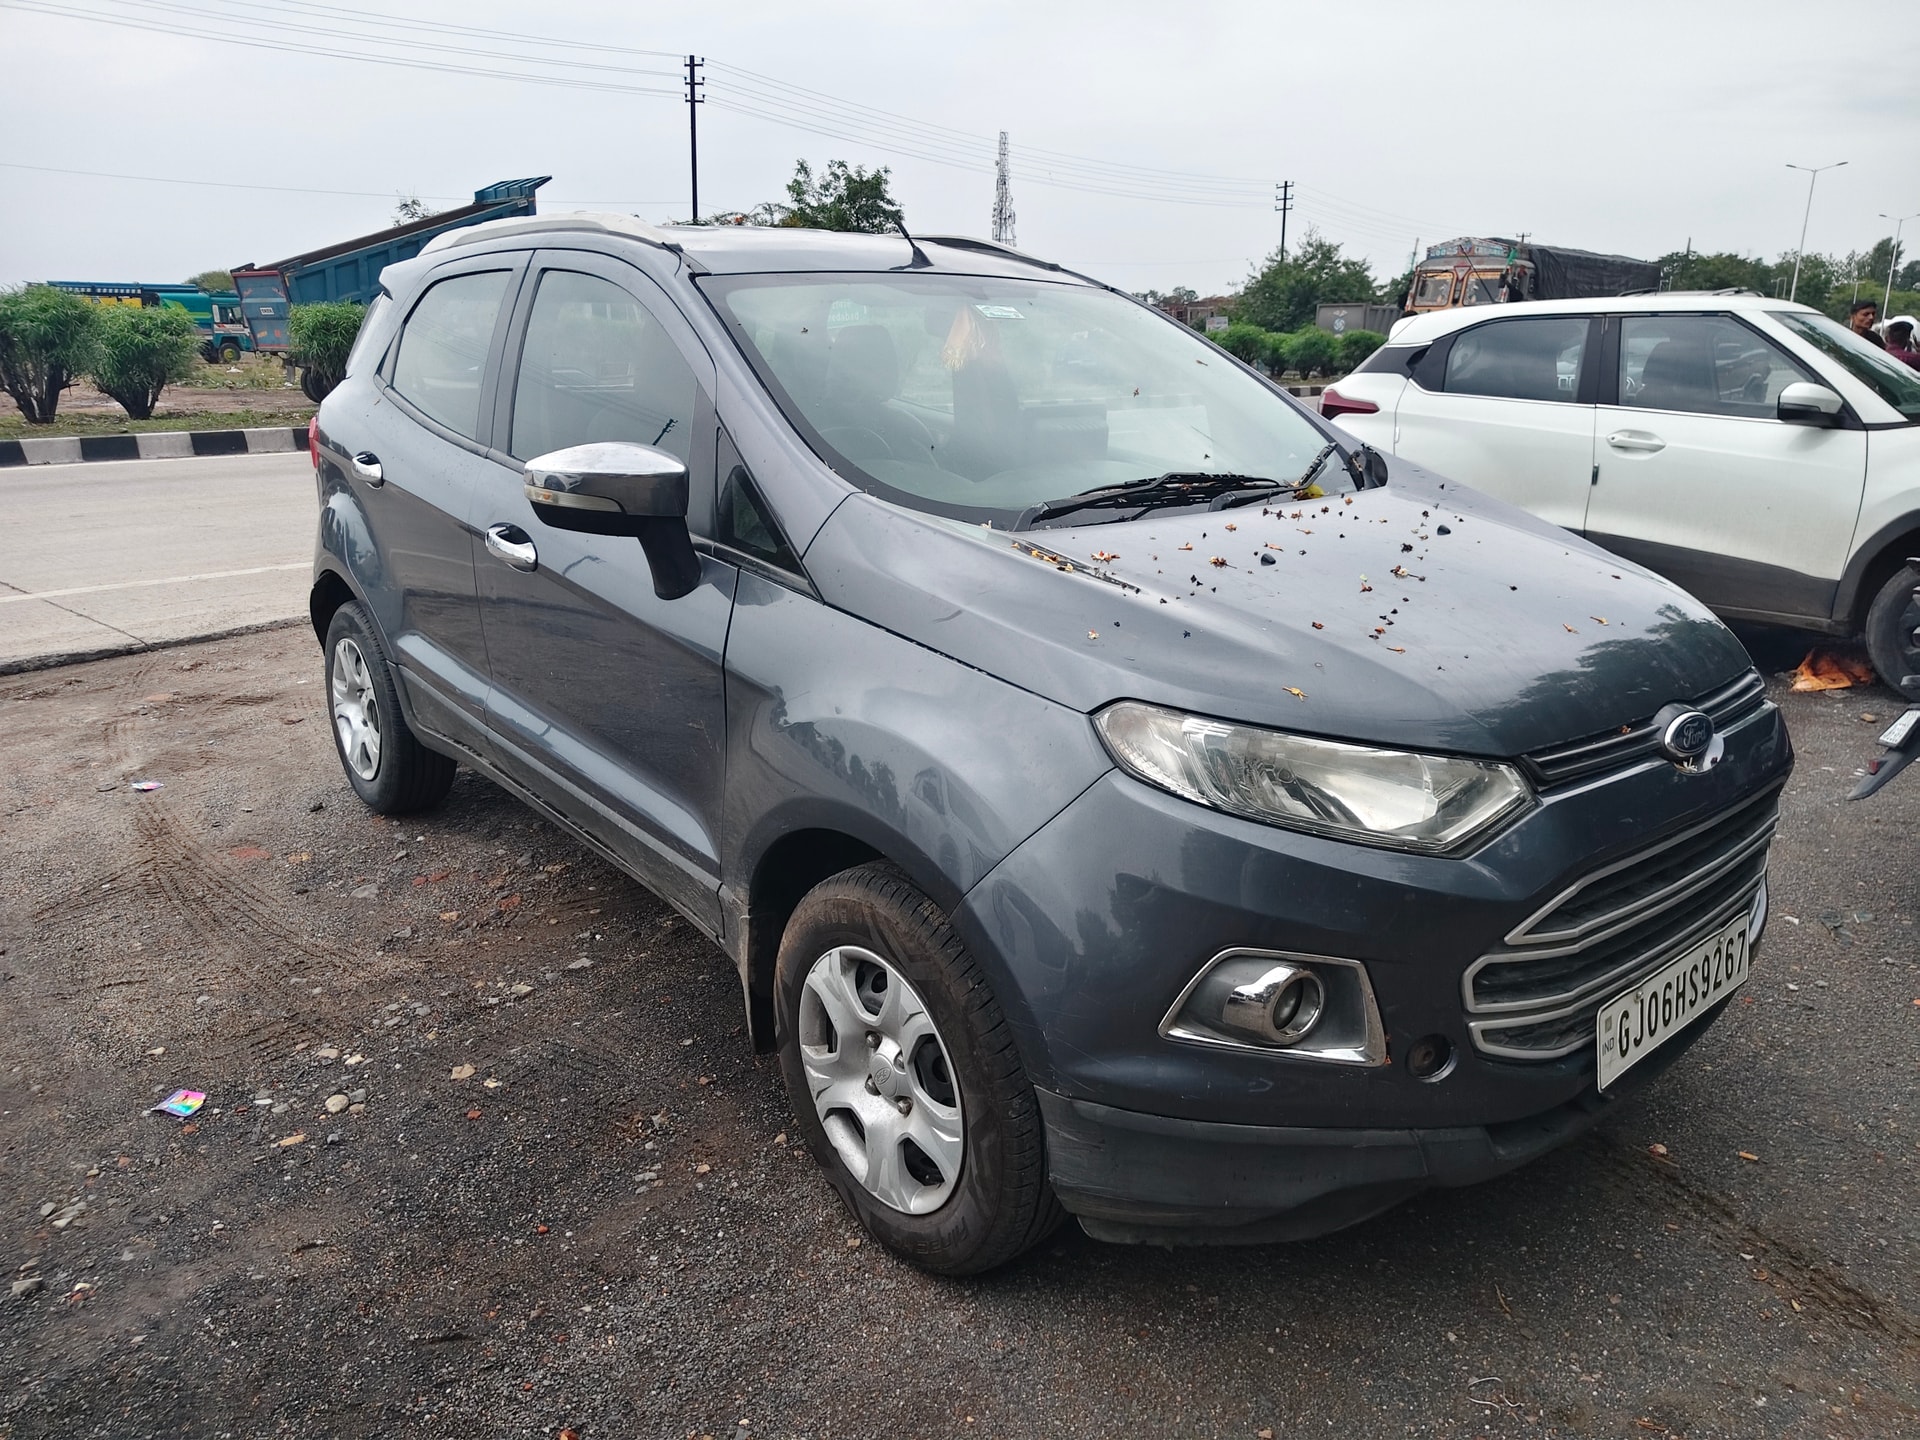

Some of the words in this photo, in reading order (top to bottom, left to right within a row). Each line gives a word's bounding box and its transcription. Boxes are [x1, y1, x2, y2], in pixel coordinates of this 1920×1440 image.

[1683, 721, 1706, 748] Ford
[1618, 929, 1746, 1058] GJ06HS9267
[1602, 1037, 1615, 1056] IND
